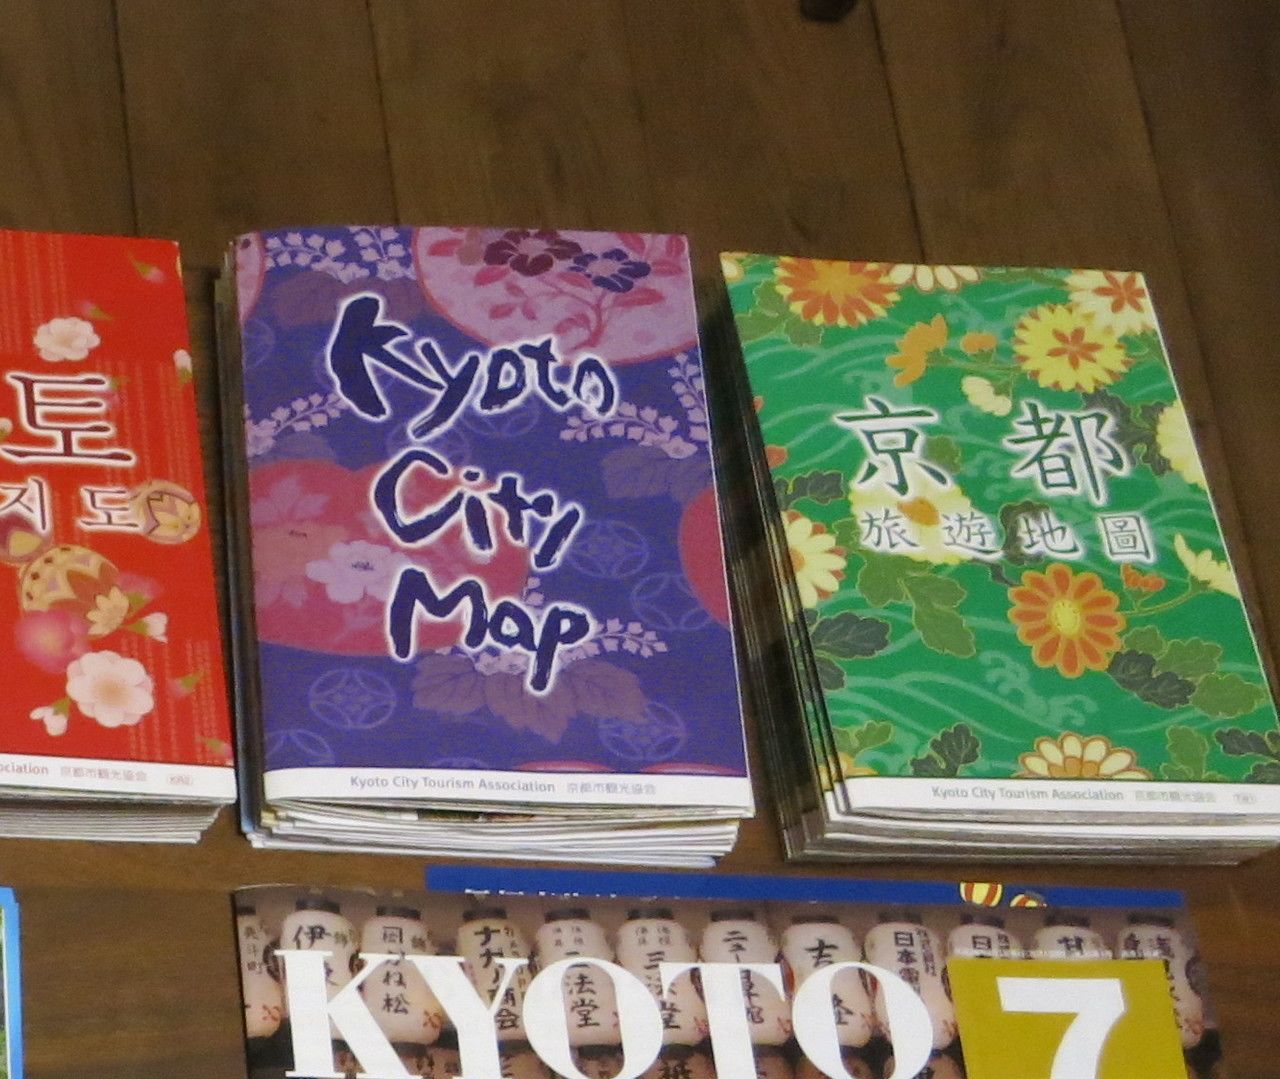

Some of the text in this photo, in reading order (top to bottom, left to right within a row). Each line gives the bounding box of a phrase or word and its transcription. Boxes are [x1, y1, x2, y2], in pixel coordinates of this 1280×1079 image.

[330, 294, 616, 438] Kyoto
[835, 398, 1129, 503] 京都
[373, 450, 582, 568] City
[862, 511, 1154, 560] 旅遊地圖
[388, 568, 591, 693] Map
[350, 776, 388, 789] Kyoto
[393, 776, 418, 790] City
[422, 777, 474, 789] Tourism
[479, 779, 554, 792] Association
